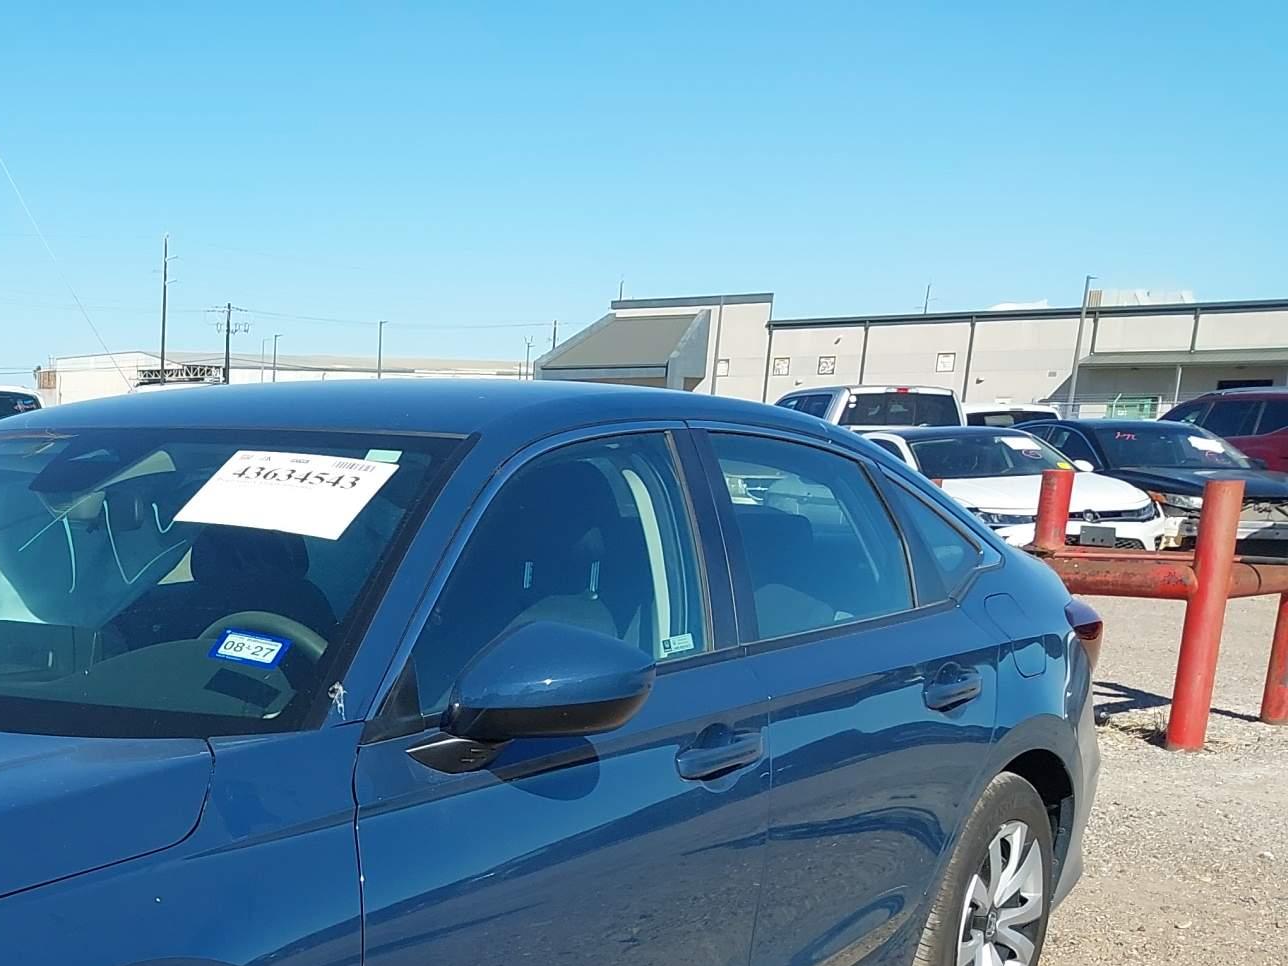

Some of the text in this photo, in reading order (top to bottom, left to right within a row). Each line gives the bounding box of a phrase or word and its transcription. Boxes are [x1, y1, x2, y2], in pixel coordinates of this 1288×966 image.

[233, 465, 361, 490] 43634543
[223, 640, 275, 658] 08 27
